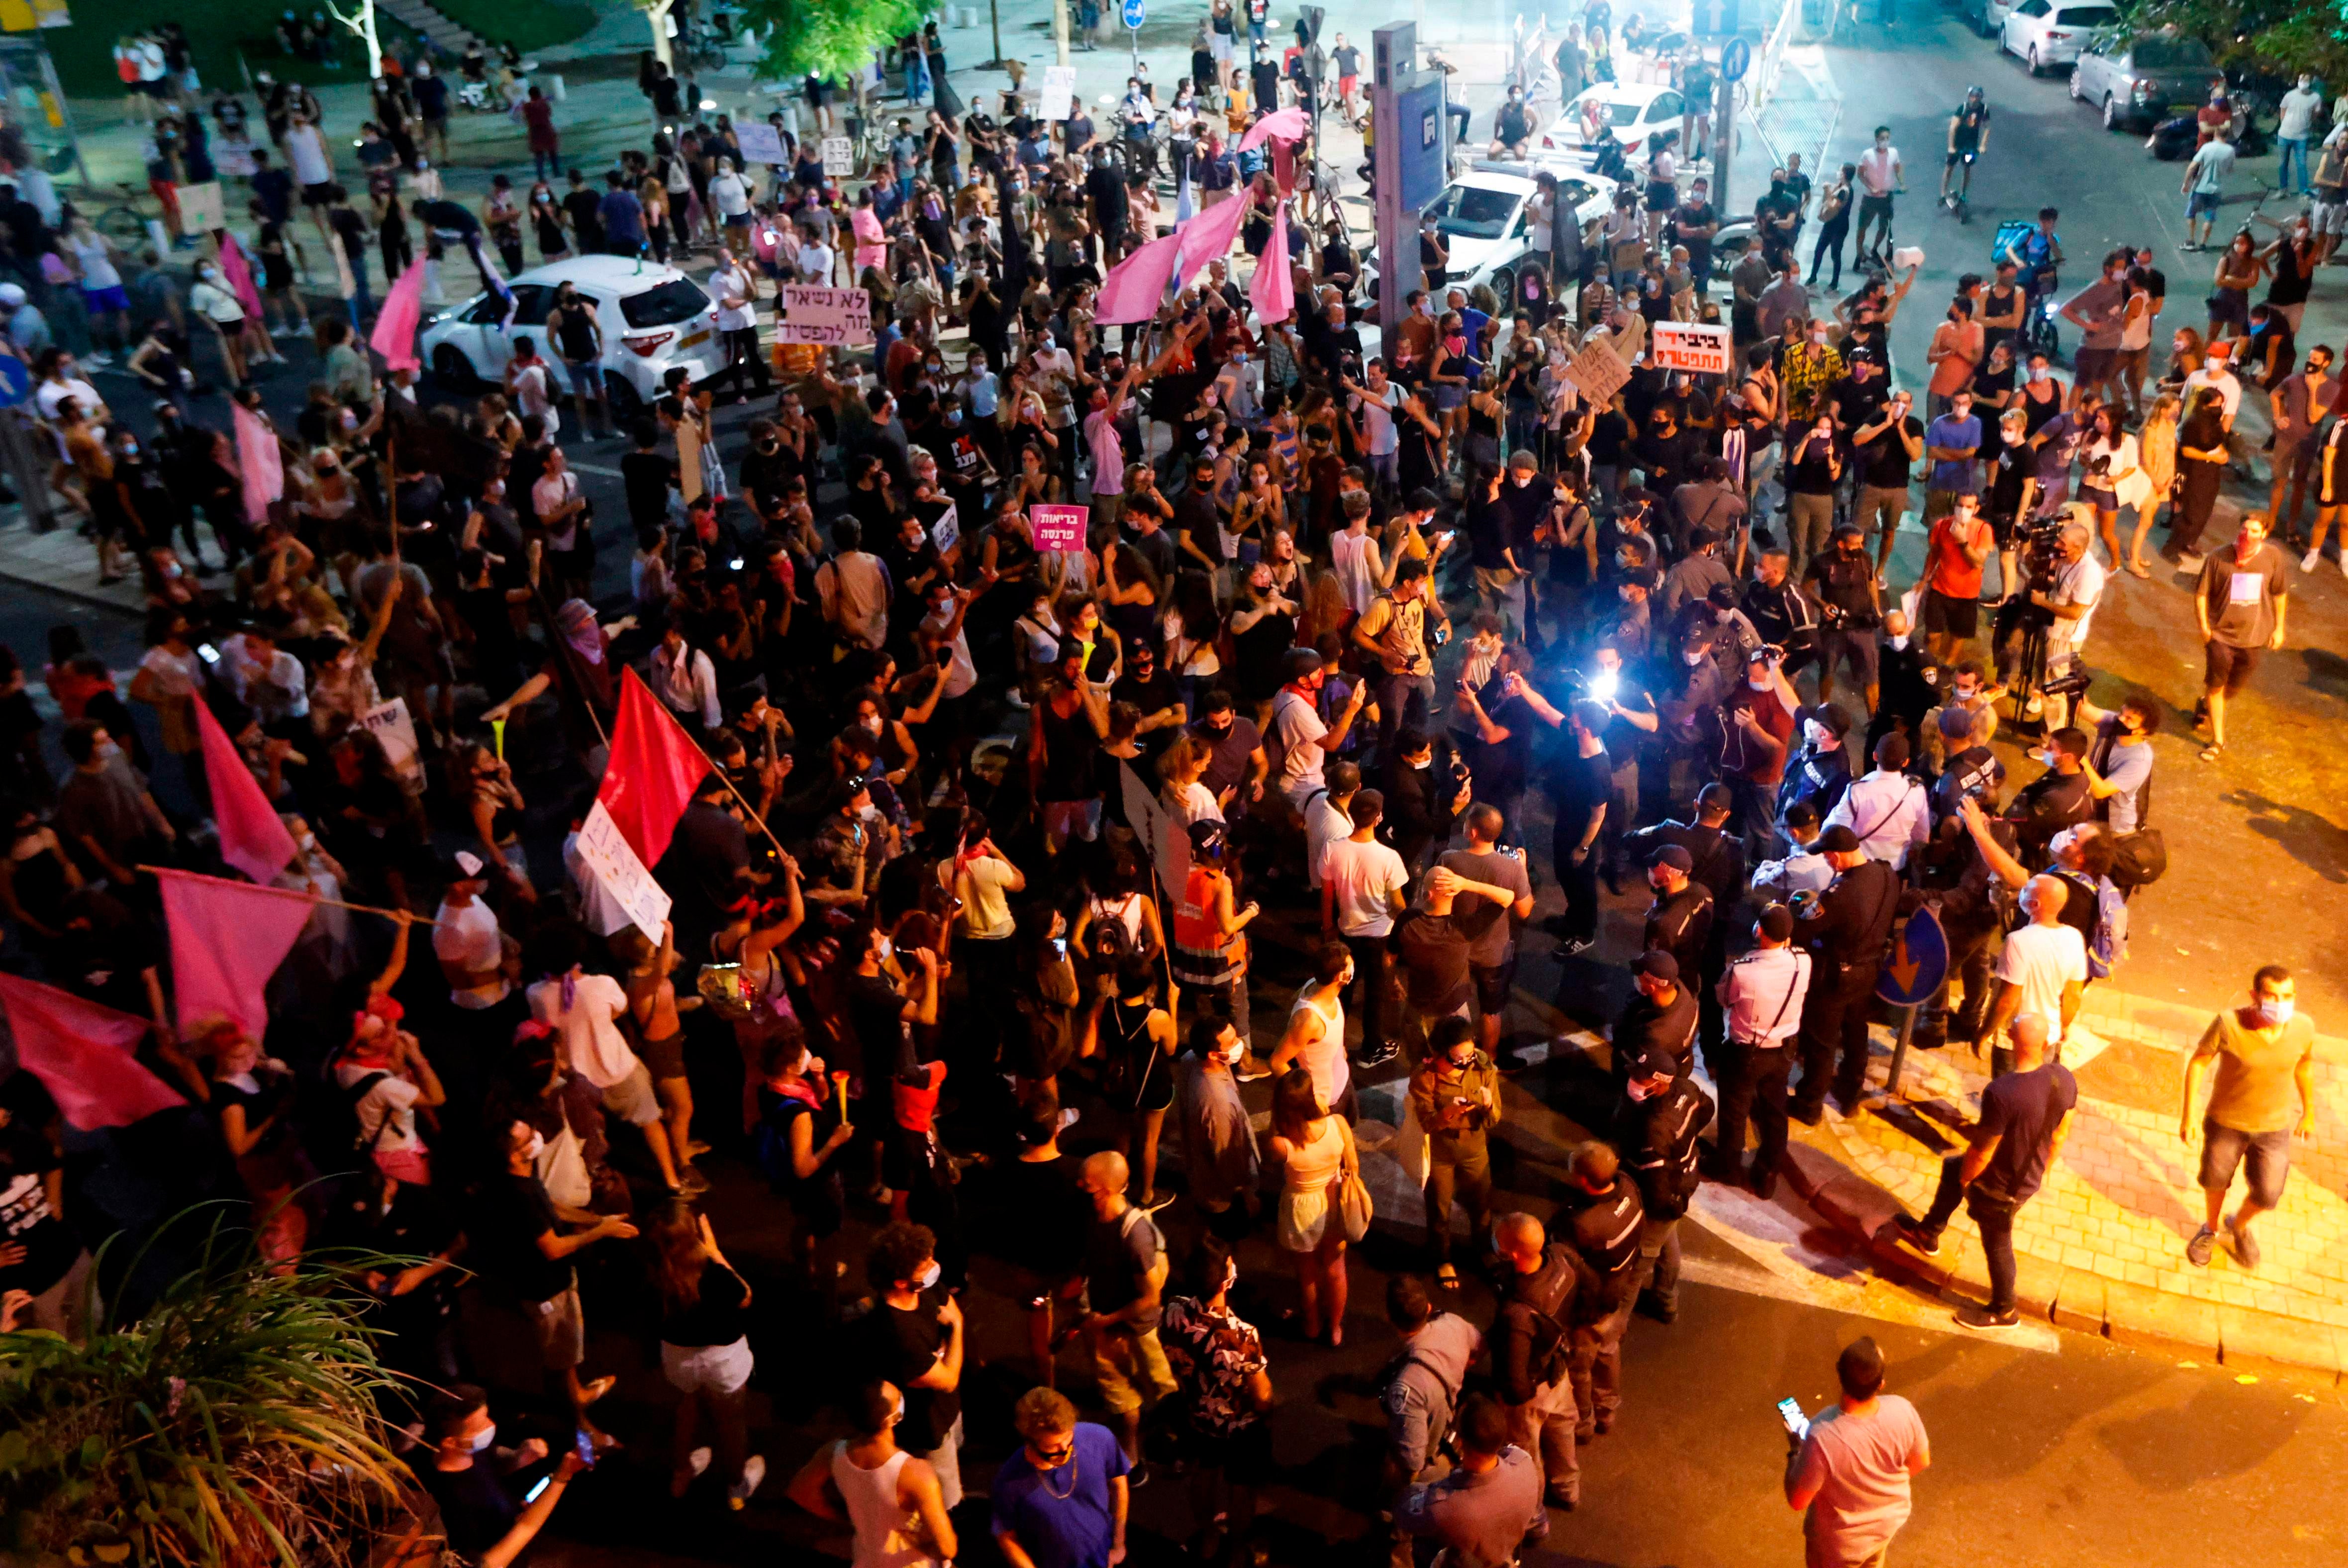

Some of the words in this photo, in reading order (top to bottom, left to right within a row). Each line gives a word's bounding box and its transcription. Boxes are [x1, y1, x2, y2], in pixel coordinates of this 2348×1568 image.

[786, 290, 833, 306] נשאר
[840, 292, 866, 309] לא
[845, 314, 869, 329] מה
[779, 324, 845, 341] להפסיד
[1656, 331, 1677, 345] די
[1678, 333, 1721, 349] ביבי
[1040, 514, 1078, 524] בריאות
[1041, 529, 1074, 539] פרנסה
